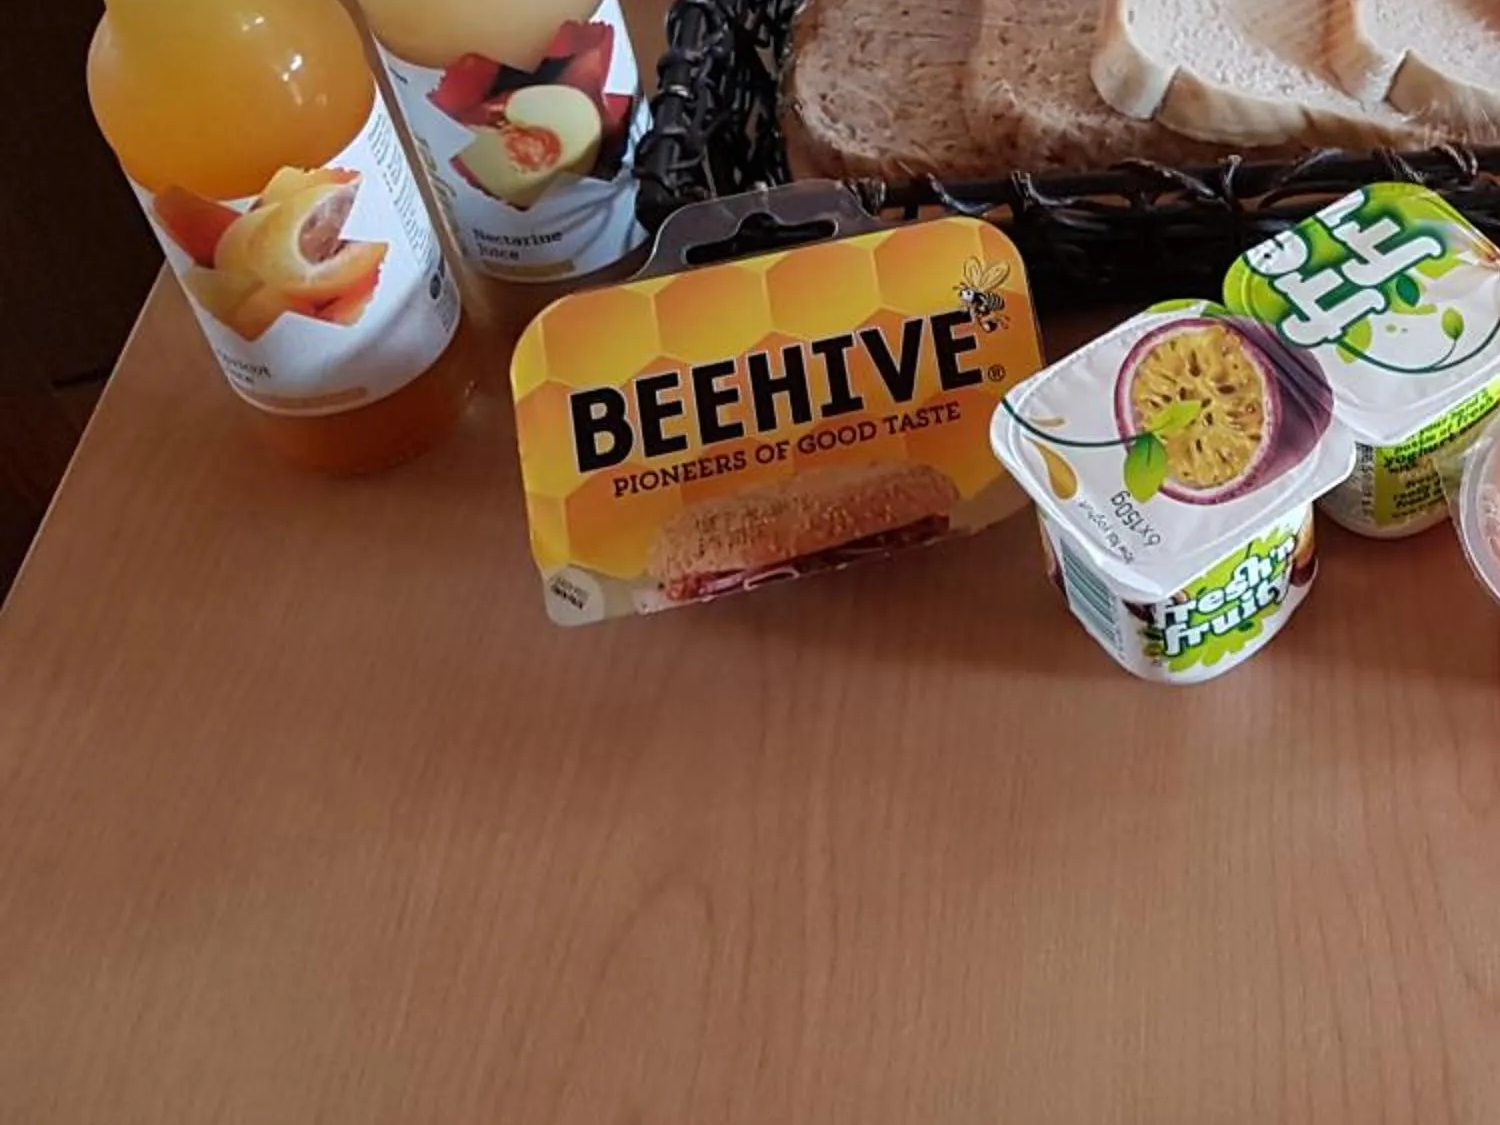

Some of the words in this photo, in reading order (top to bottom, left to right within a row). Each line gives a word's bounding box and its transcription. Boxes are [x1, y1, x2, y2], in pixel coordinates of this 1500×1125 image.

[567, 309, 986, 477] BEEHIVE
[612, 449, 747, 499] PIONEERS
[754, 440, 790, 465] OF
[797, 419, 877, 456] GOOD
[883, 400, 962, 435] TASTE
[1164, 573, 1290, 657] fruity
